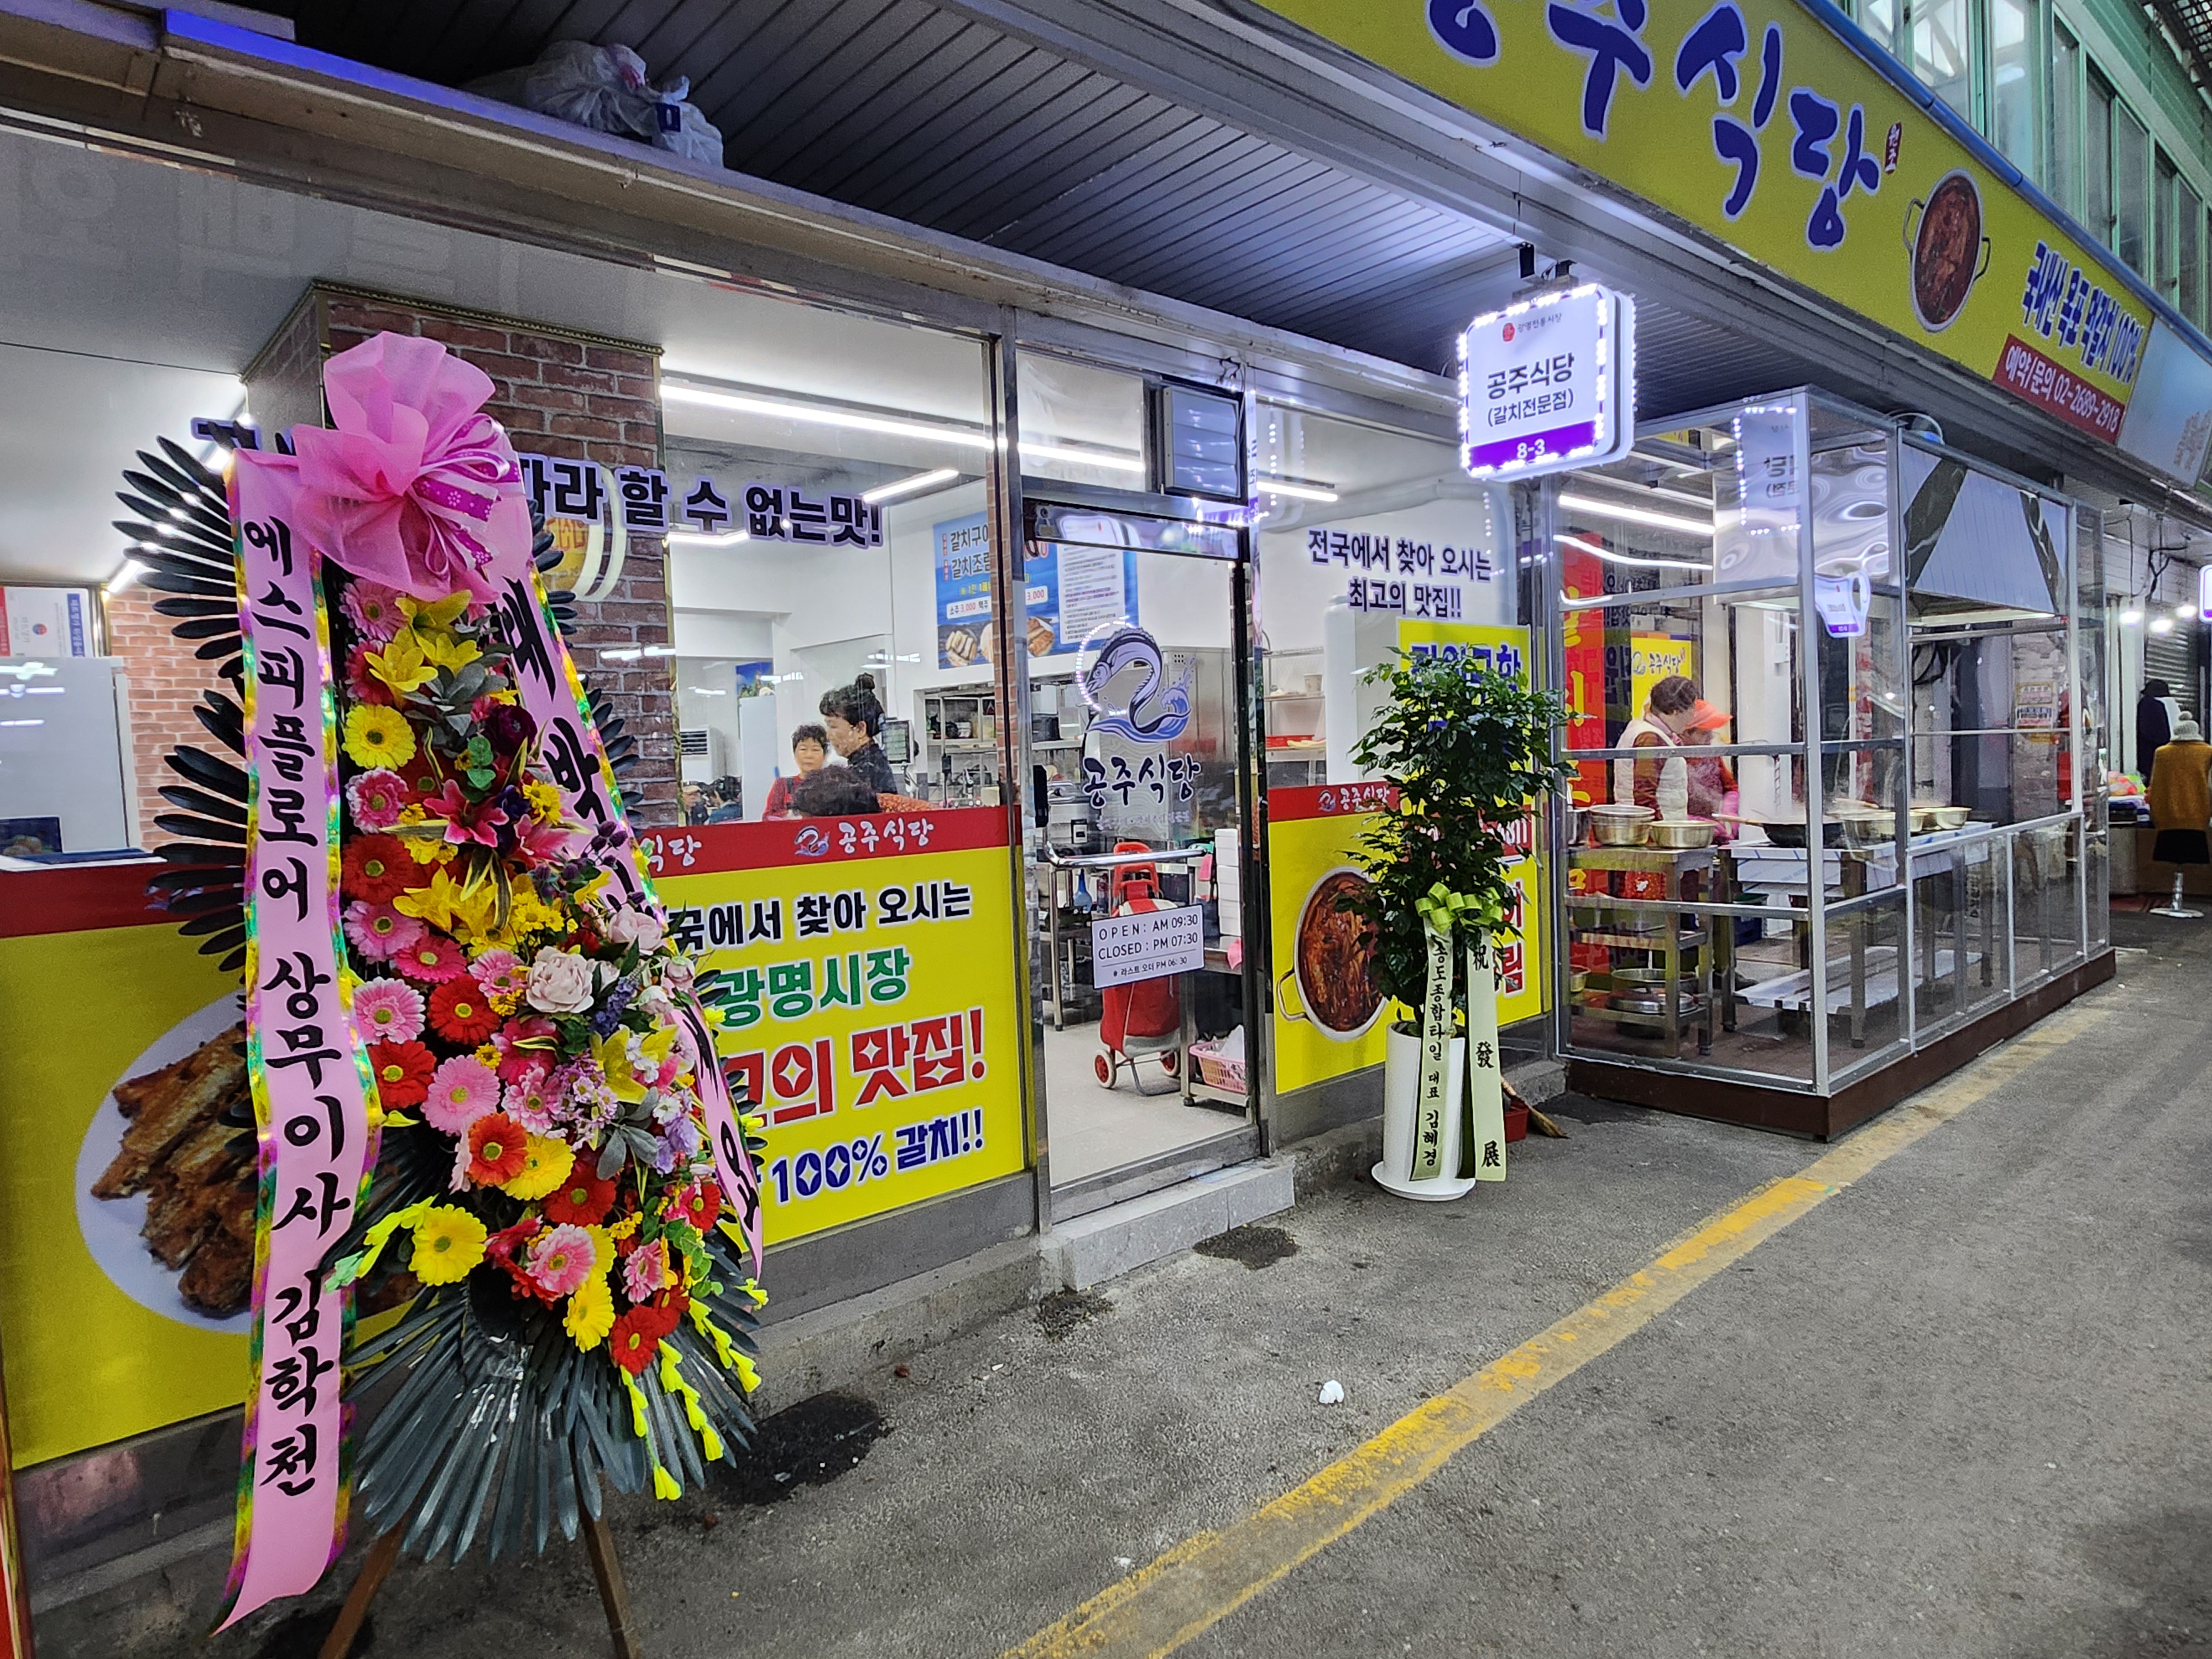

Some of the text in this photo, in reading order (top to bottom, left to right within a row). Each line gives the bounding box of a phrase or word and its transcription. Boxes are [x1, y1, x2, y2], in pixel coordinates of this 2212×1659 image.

[1425, 0, 1881, 247] 주식당
[2022, 239, 2146, 384] 국내산 목포 먹갈치 100%
[1487, 352, 1575, 400] 공주식당
[2005, 345, 2121, 434] 예약/문의 02-2689-2918
[1488, 388, 1574, 427] (갈치전문점)
[1516, 439, 1546, 458] 8-3
[619, 470, 669, 527] 할
[686, 481, 728, 532] 수
[1307, 528, 1492, 582] 전국에서 찾아 오시는
[950, 605, 959, 615] 소주
[1027, 589, 1045, 601] 3,000
[1349, 577, 1462, 620] 최고의 맛집!!
[1648, 652, 1681, 675] 공주식당
[1083, 753, 1201, 808] 공주식당
[639, 834, 702, 872] 식당
[838, 817, 934, 854] 공주식당
[664, 880, 972, 952] 국에서 찾아 오시는
[1099, 923, 1140, 941] OPEN
[1152, 918, 1168, 932] AM
[1171, 914, 1198, 928] 09:30
[1098, 942, 1142, 960] CLOSED
[1153, 937, 1168, 951] PM
[1171, 932, 1198, 947] 07:30
[1120, 966, 1140, 977] 라스트
[1142, 963, 1154, 973] 오더
[1156, 961, 1166, 969] PM
[713, 948, 911, 1027] 광명시장
[261, 951, 351, 1240] 상무이사
[724, 1008, 985, 1129] 고의 맛집!
[1426, 1071, 1440, 1099] 대표
[772, 1109, 984, 1203] 100% 갈치!!
[1422, 1108, 1440, 1167] 김혜경
[260, 1268, 334, 1497] 김학천
